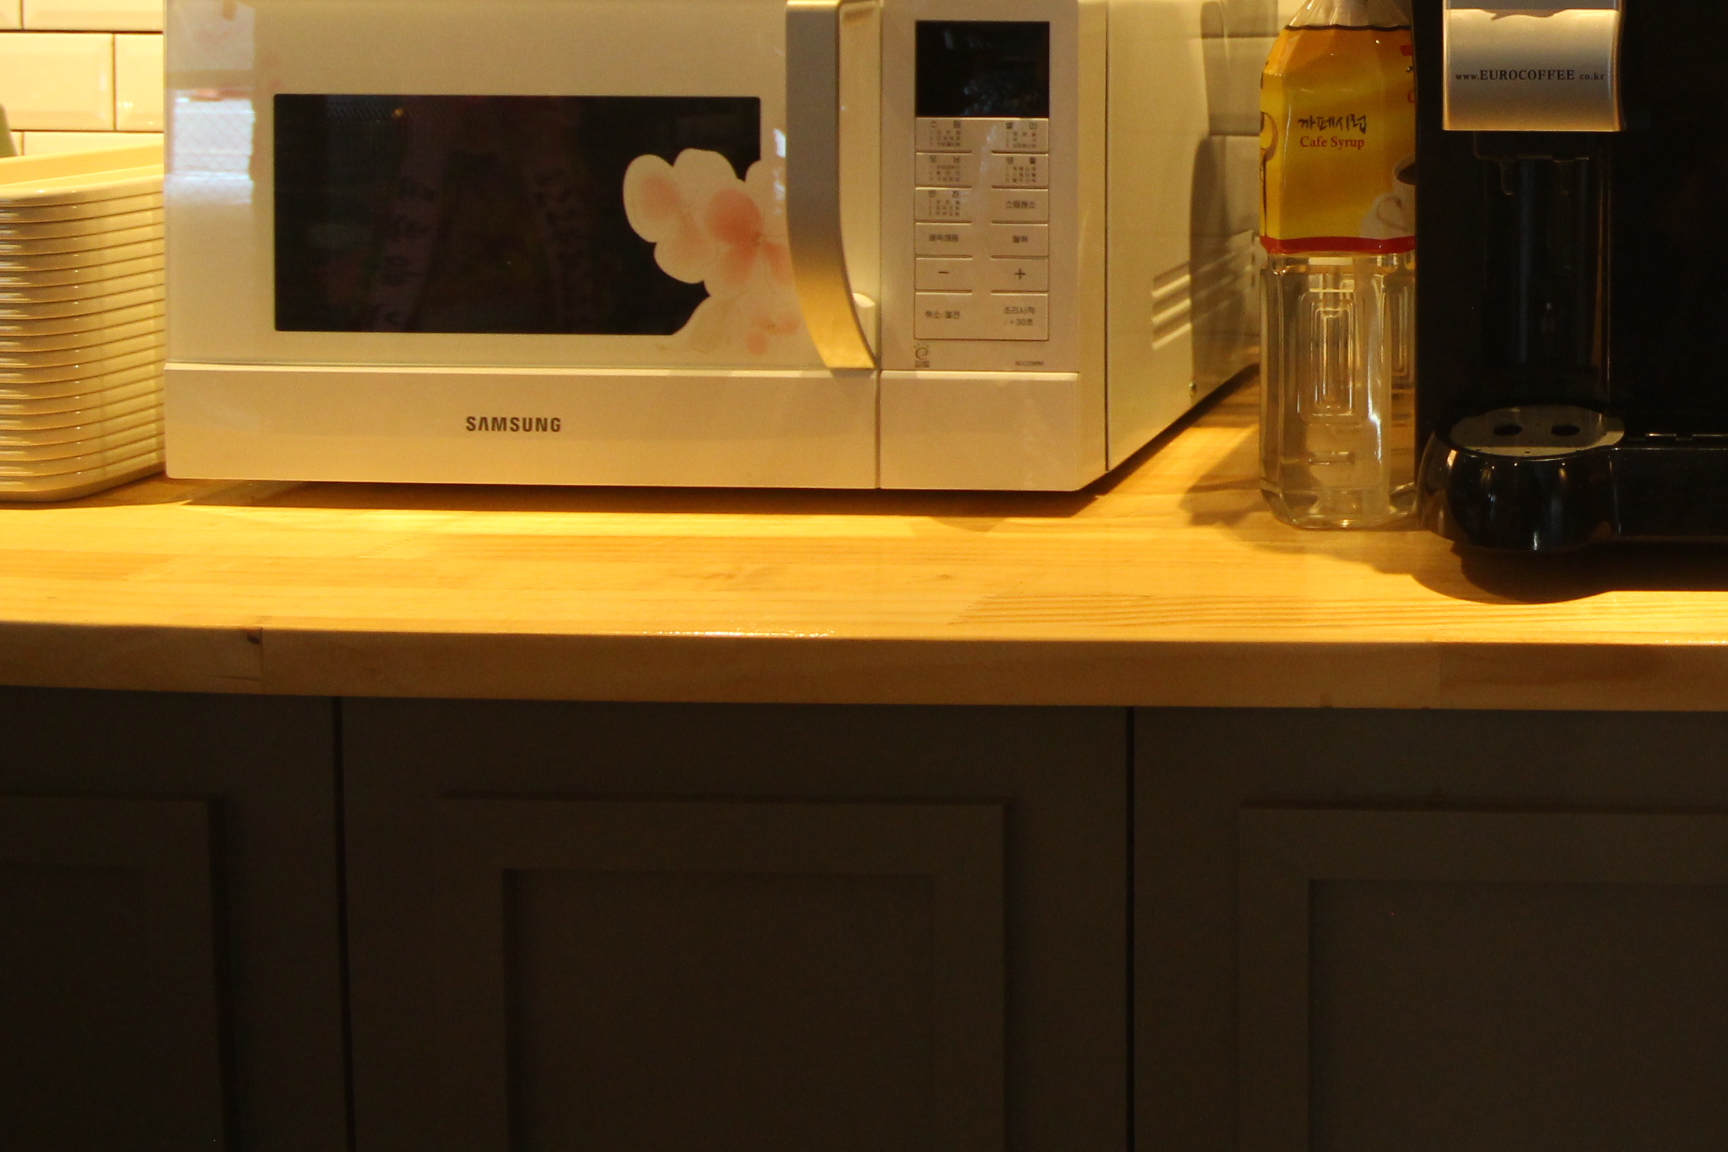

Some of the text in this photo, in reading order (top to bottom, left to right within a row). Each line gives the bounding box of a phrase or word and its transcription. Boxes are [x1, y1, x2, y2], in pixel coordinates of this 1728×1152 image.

[1300, 136, 1365, 150] Cafe Syrup
[465, 416, 562, 433] SAMSUNG
